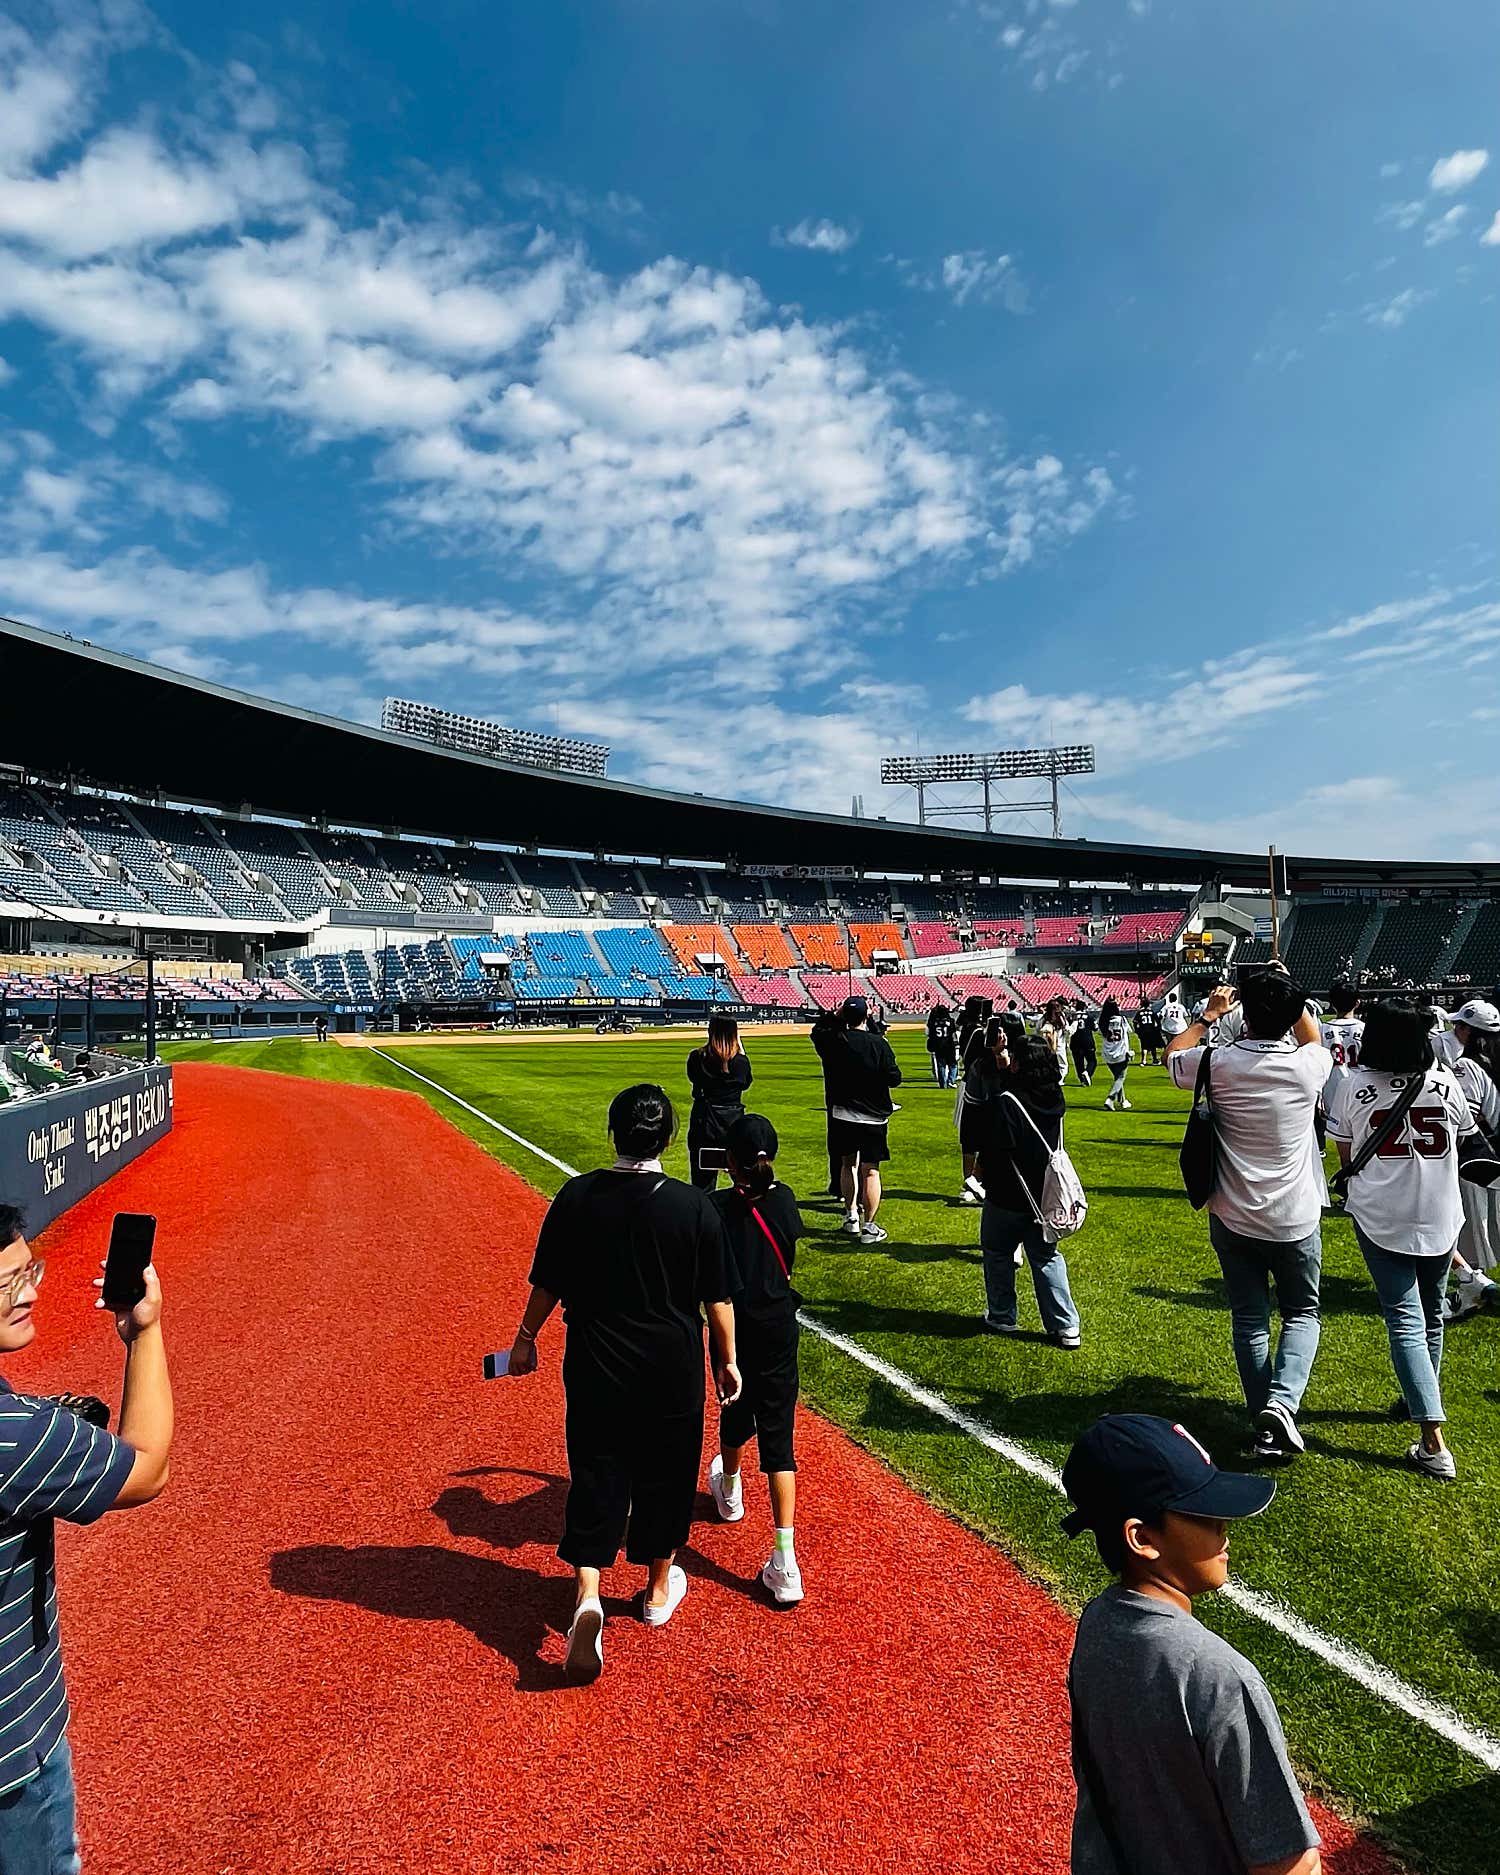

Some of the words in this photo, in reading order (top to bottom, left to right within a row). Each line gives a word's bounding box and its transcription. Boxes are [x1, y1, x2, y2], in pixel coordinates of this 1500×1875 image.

[935, 1026, 948, 1038] 51
[28, 1127, 50, 1166] Only
[50, 1117, 75, 1154] Think!
[85, 1094, 132, 1163] 백조씽크
[1368, 1106, 1450, 1160] 25
